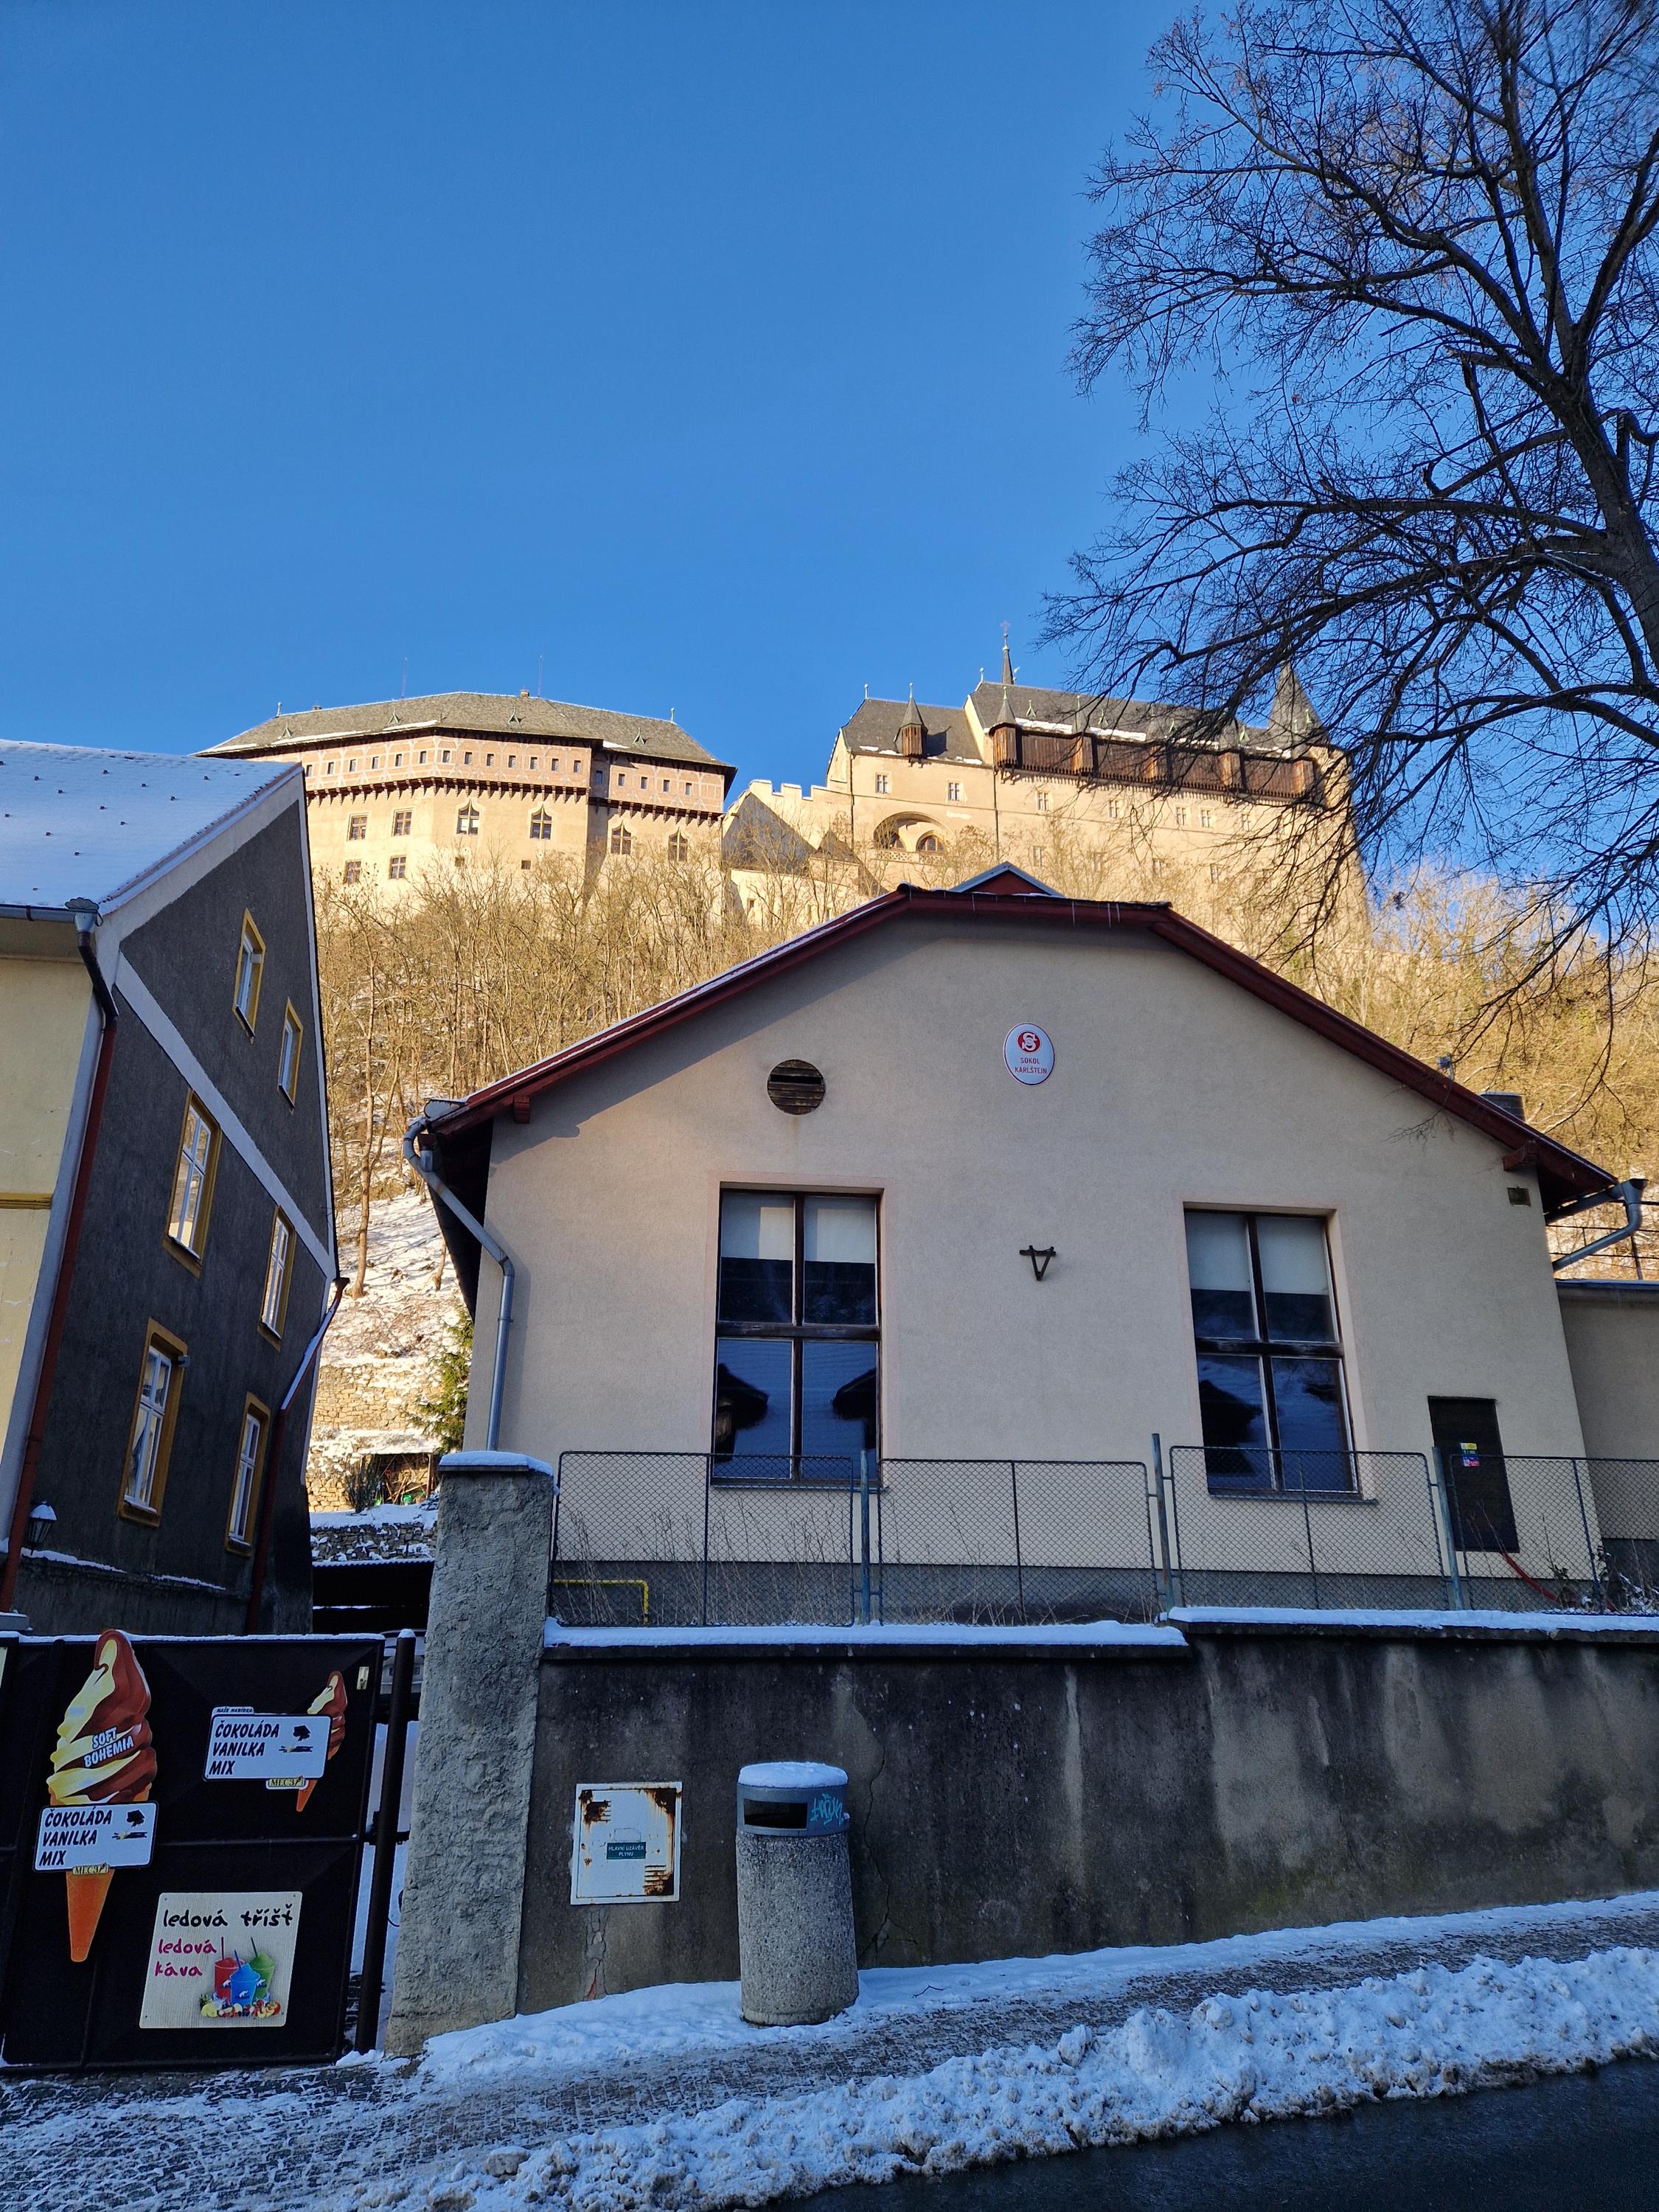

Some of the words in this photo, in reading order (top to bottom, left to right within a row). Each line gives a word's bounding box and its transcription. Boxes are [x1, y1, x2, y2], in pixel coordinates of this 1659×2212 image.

[1020, 1057, 1040, 1065] SOKOL
[1015, 1066, 1047, 1074] KARLŠTEJN
[93, 1727, 116, 1748] SOFT
[215, 1720, 279, 1739] ČOKOLÁDA
[84, 1736, 134, 1767] BOHEMIA
[212, 1742, 265, 1757] VANILKA
[209, 1761, 235, 1775] MIX
[45, 1806, 113, 1828] ČOKOLÁDA
[43, 1829, 97, 1847] VANILKA
[38, 1850, 66, 1866] MIX
[163, 1909, 228, 1927] ledová
[240, 1903, 293, 1927] tříšť
[158, 1938, 217, 1954] ledová
[155, 1961, 203, 1977] káva
